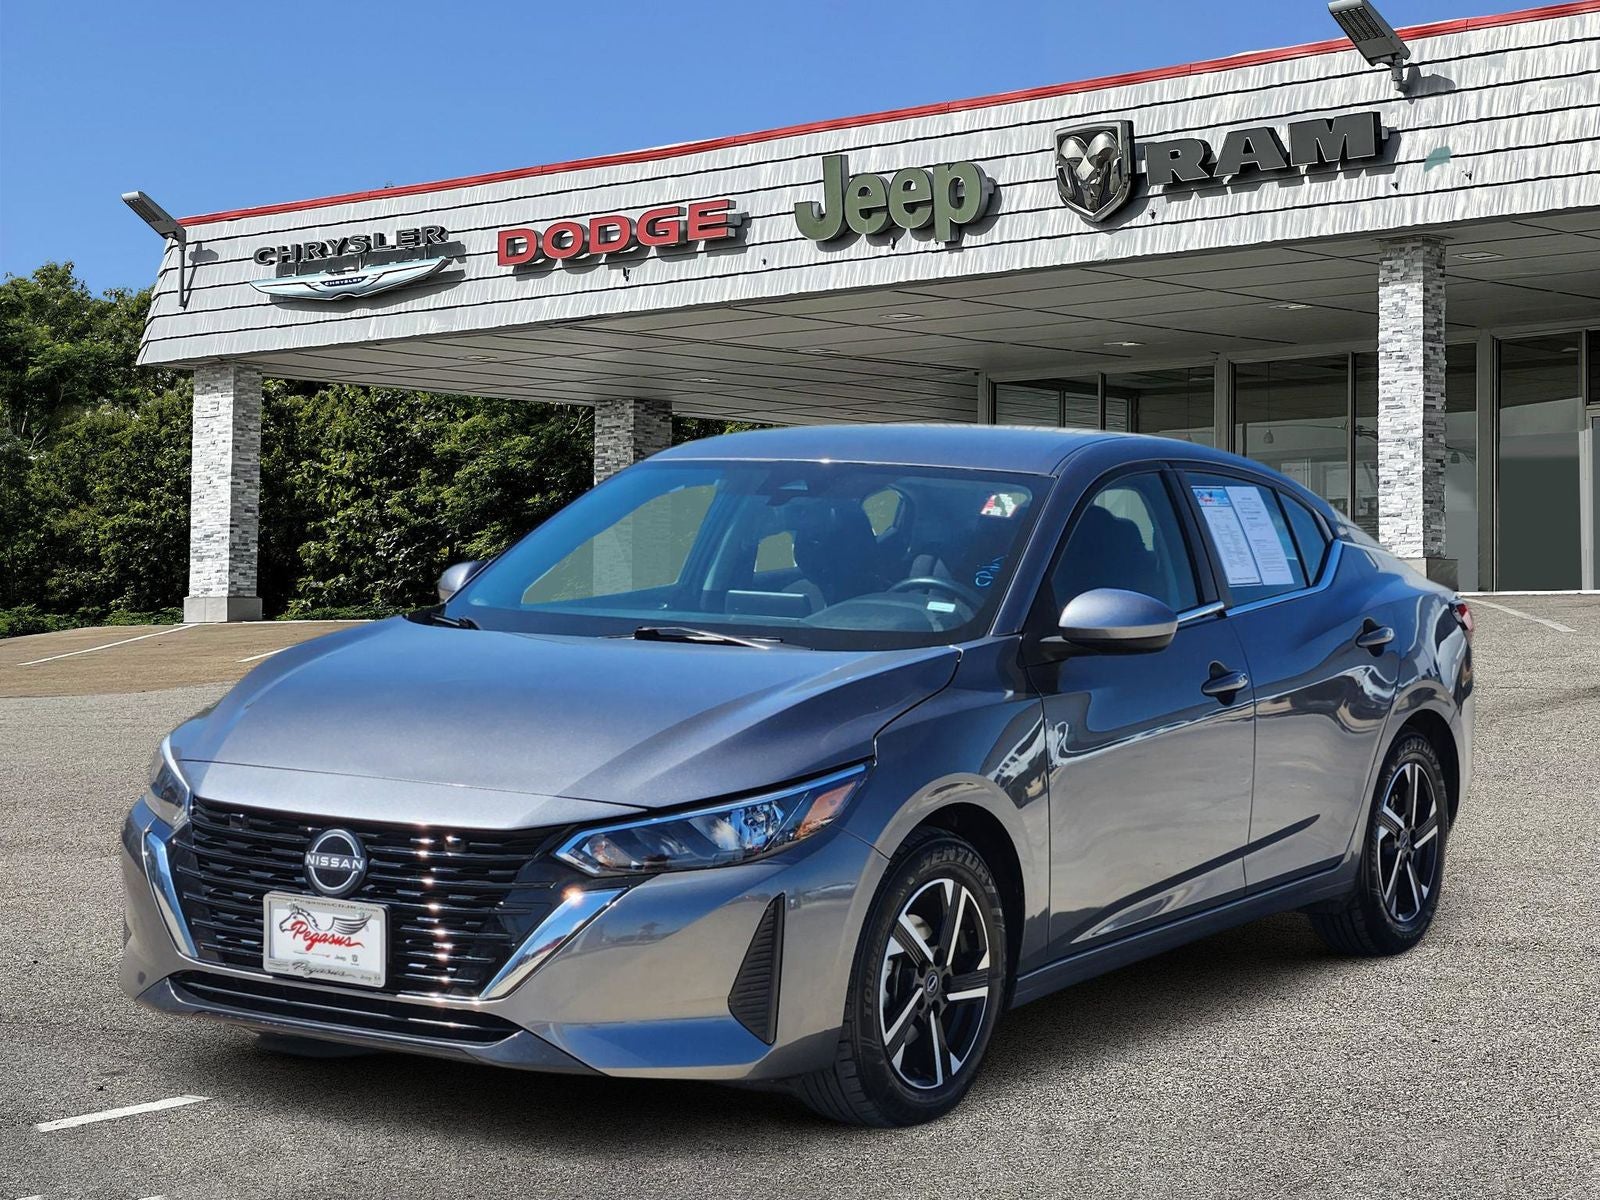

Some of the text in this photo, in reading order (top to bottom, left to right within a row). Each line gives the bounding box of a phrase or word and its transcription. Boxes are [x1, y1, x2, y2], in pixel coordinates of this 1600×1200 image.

[1145, 111, 1379, 187] RAM
[794, 154, 983, 243] Jeep
[253, 225, 449, 266] CHRYSLER
[497, 199, 734, 267] DODGE
[324, 276, 363, 287] CHRYSLER
[305, 854, 364, 870] NISSAN
[291, 920, 365, 951] Pegasus
